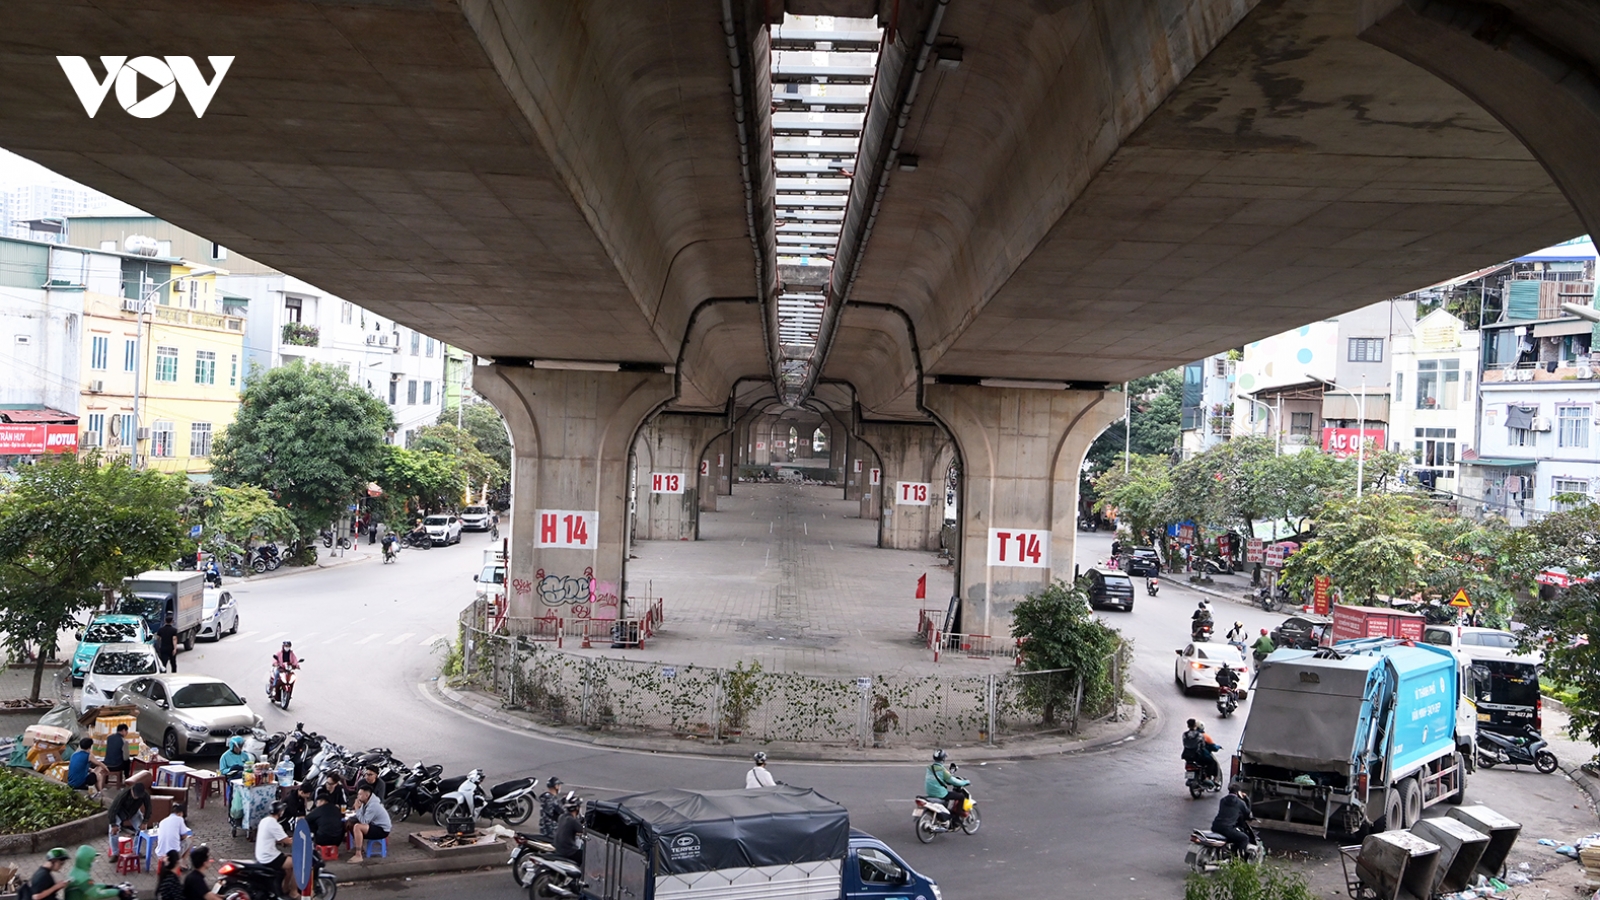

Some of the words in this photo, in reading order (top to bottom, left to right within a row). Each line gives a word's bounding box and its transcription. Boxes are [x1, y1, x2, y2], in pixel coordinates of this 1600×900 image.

[47, 433, 76, 445] MOTUL
[1329, 429, 1346, 449] ẮC
[653, 475, 662, 491] H
[665, 475, 679, 491] 13
[873, 470, 879, 482] T
[902, 484, 910, 500] T
[912, 485, 927, 501] 13
[541, 514, 557, 543] H
[563, 514, 588, 545] 14
[997, 532, 1011, 562] T
[1016, 533, 1042, 564] 14
[672, 845, 700, 853] TERACO
